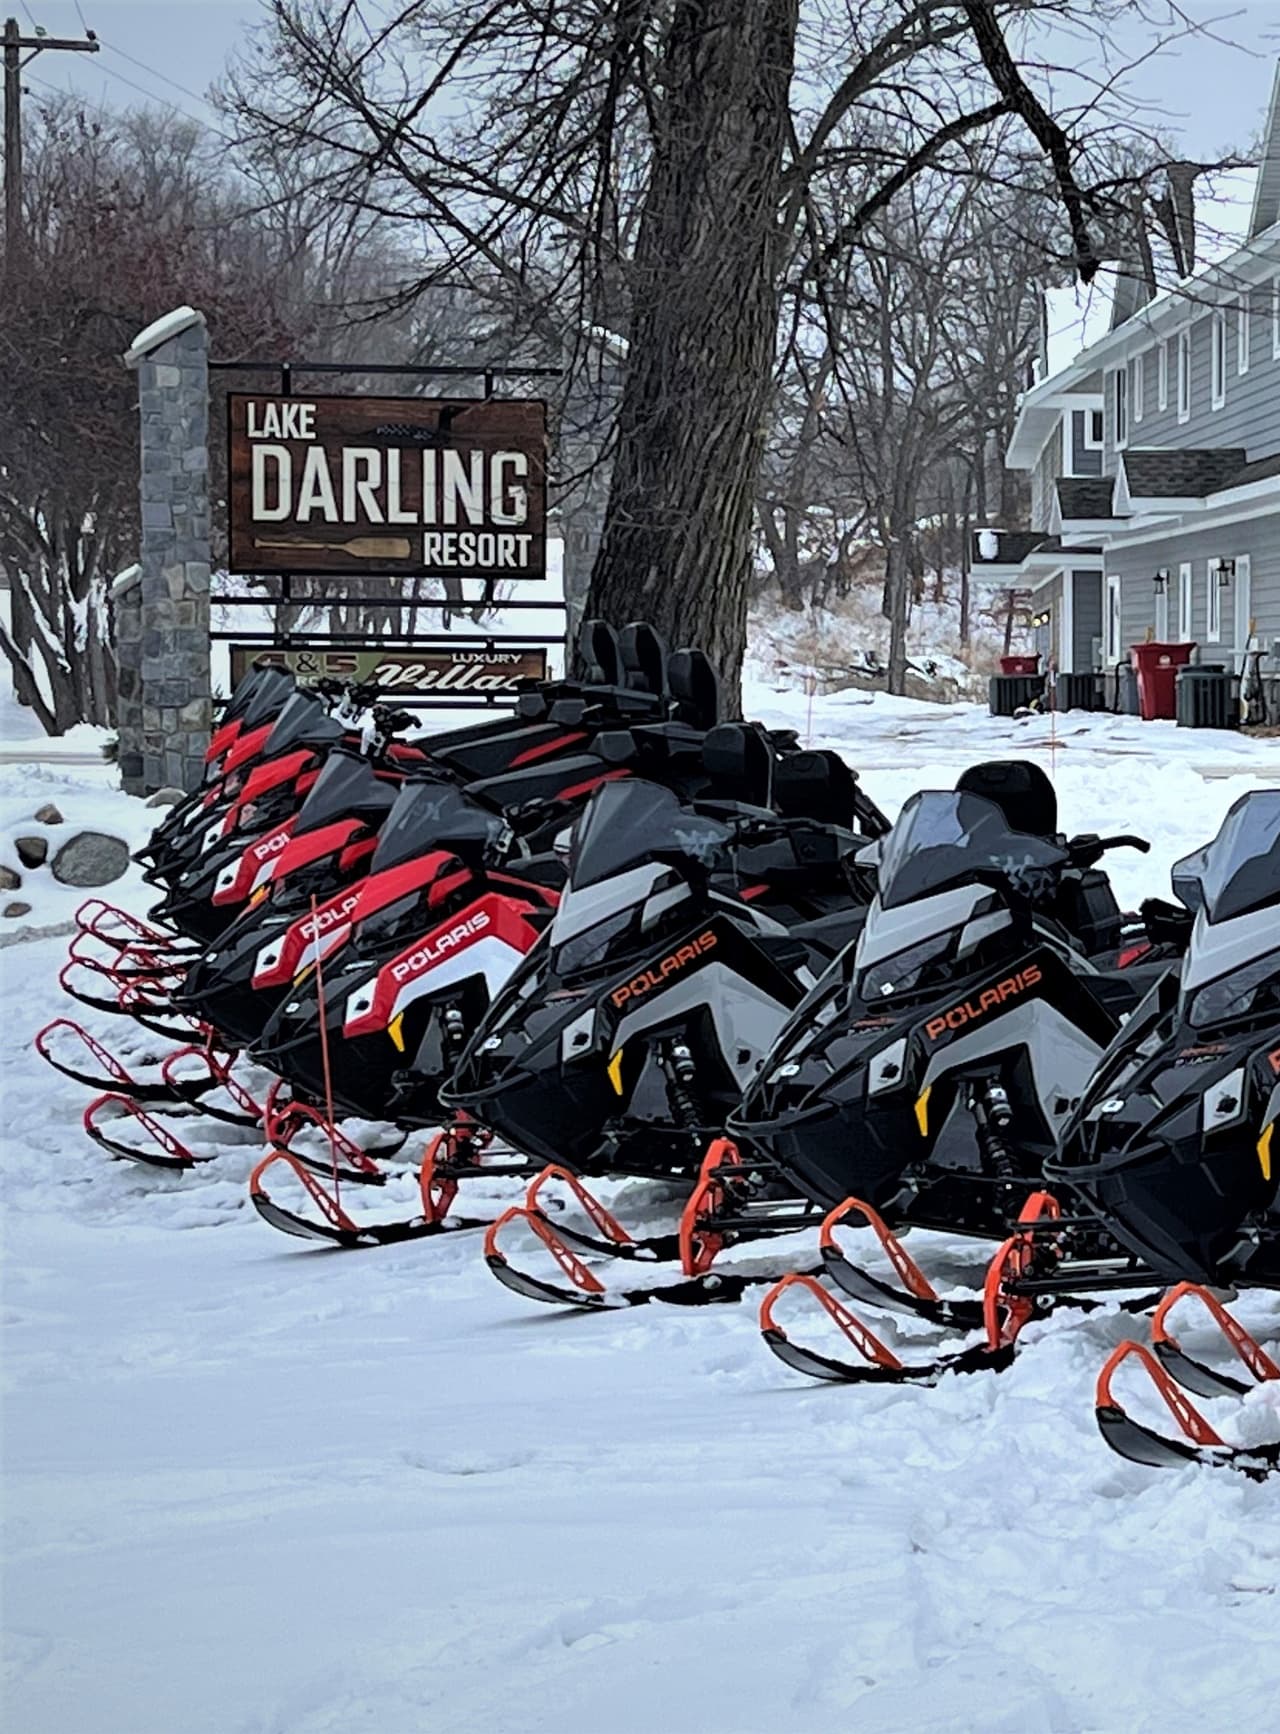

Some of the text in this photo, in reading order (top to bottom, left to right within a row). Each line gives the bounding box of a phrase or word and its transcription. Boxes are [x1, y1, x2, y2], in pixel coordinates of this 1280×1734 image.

[247, 402, 316, 439] LAKE
[251, 445, 528, 525] DARLING
[423, 532, 532, 567] RESORT
[296, 652, 319, 674] &
[452, 653, 522, 664] LUXURY
[390, 910, 491, 981] POLARIS
[611, 930, 718, 1008] POLARIS
[925, 964, 1042, 1040] POLARIS
